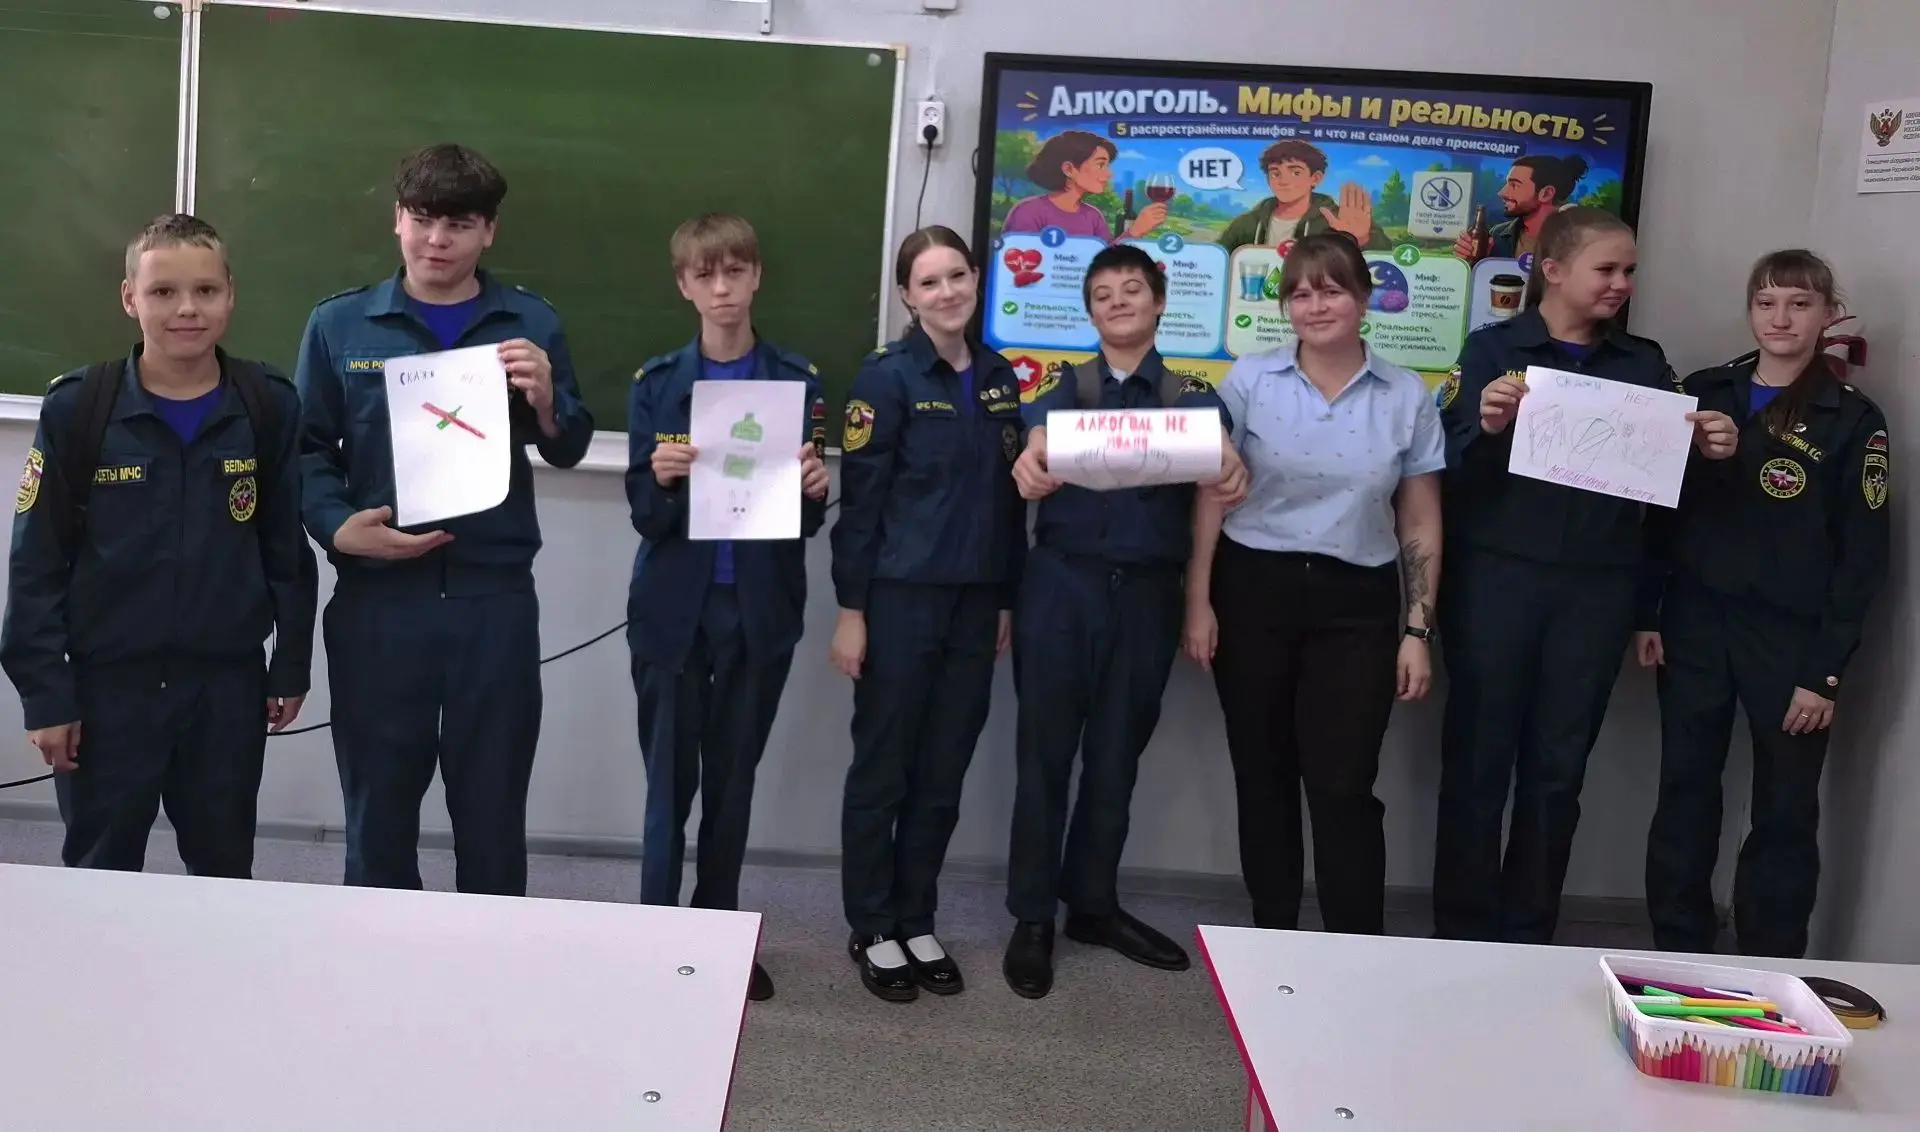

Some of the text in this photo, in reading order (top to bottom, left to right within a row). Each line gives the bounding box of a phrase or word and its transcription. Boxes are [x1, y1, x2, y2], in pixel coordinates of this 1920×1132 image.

[1048, 84, 1585, 141] Алкоголь. Мифы и реальность
[1116, 123, 1128, 136] 5
[1130, 123, 1249, 137] распространённых
[1252, 126, 1295, 138] мифов
[1314, 129, 1322, 138] и
[1326, 129, 1347, 140] что
[1350, 131, 1365, 141] на
[1368, 133, 1410, 144] самом
[1412, 135, 1444, 147] деле
[1446, 137, 1520, 155] происходит
[1189, 159, 1232, 178] НЕТ
[1048, 230, 1058, 245] 1
[1164, 236, 1177, 251] 2
[1053, 254, 1079, 263] Миф:
[1400, 248, 1412, 263] 4
[1172, 260, 1197, 269] Миф:
[1415, 273, 1440, 282] Миф:
[1414, 285, 1455, 293] «Алкоголь
[1024, 302, 1080, 313] Реальность:
[1431, 303, 1460, 311] снимает
[1375, 322, 1432, 333] Реальность:
[1374, 342, 1398, 350] стресс
[350, 361, 370, 370] МЧС
[1625, 391, 1656, 407] НЕТ
[1165, 415, 1188, 433] НЕ
[656, 432, 674, 443] МЧС
[119, 465, 142, 481] МЧС
